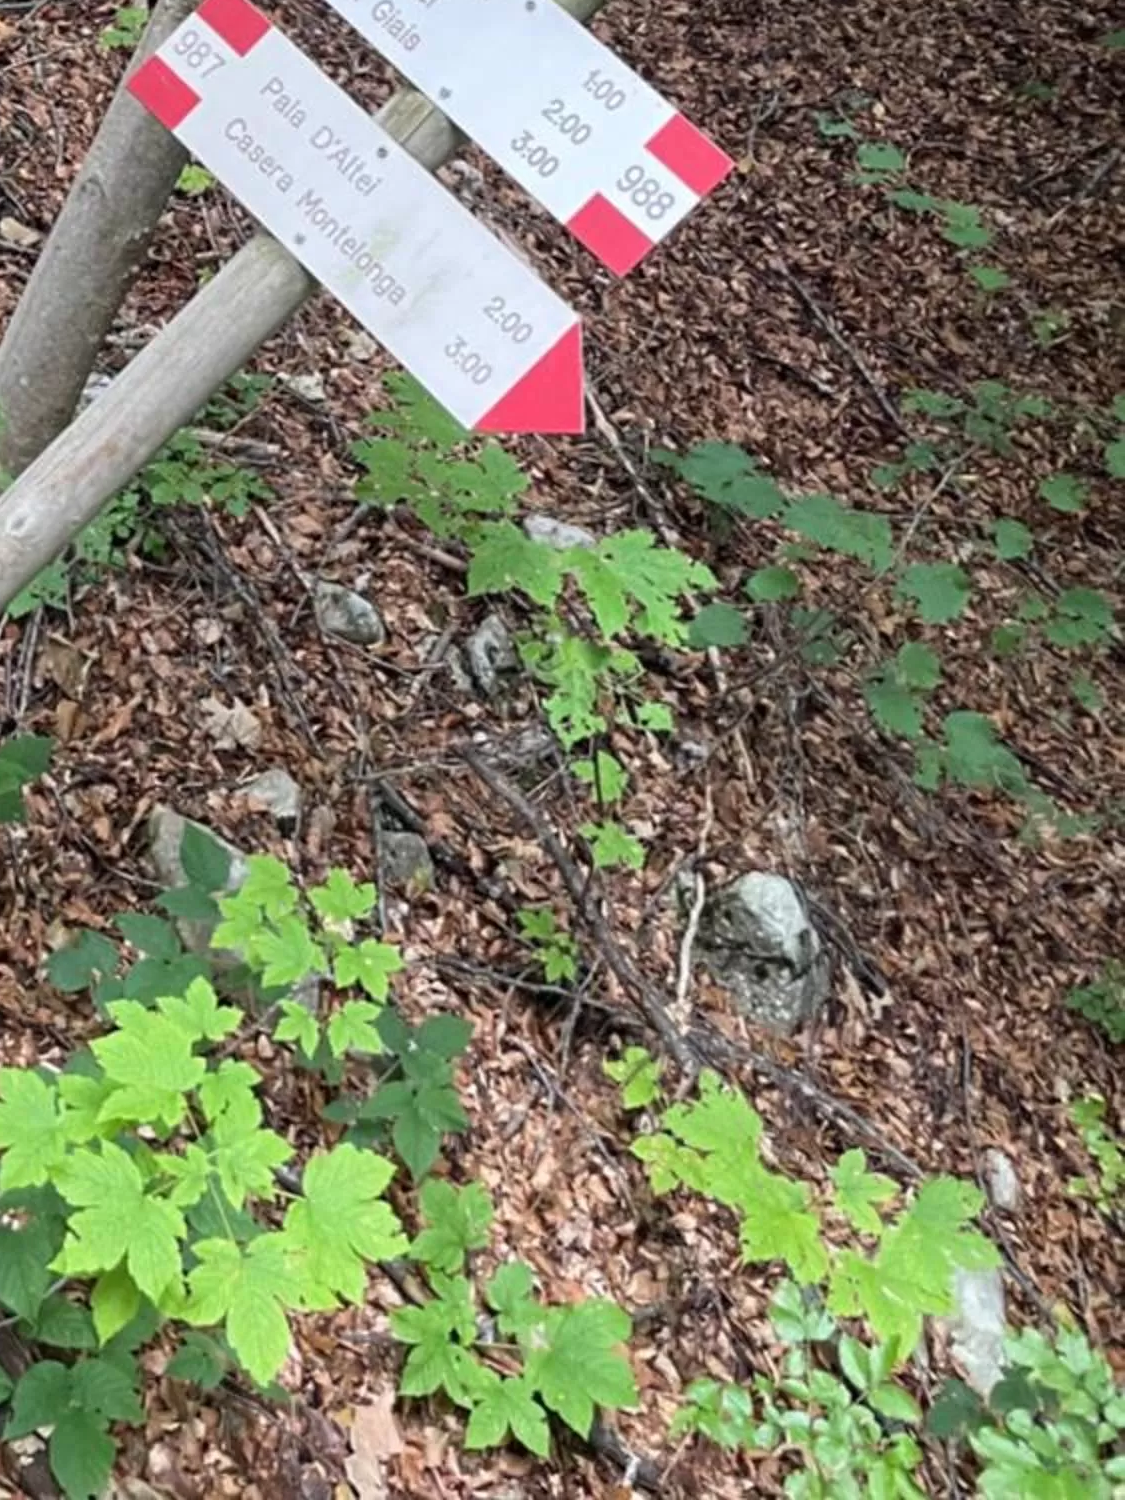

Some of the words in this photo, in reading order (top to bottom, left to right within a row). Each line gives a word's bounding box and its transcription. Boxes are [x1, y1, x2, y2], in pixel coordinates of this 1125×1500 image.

[174, 29, 227, 79] 987
[582, 69, 627, 112] 1:00
[541, 99, 593, 146] 2:00
[510, 131, 560, 179] 3:00
[615, 164, 675, 221] 988
[223, 118, 293, 193] Casera
[296, 187, 408, 307] Montelonga
[444, 336, 493, 385] 3:00
[482, 296, 534, 344] 2:00
